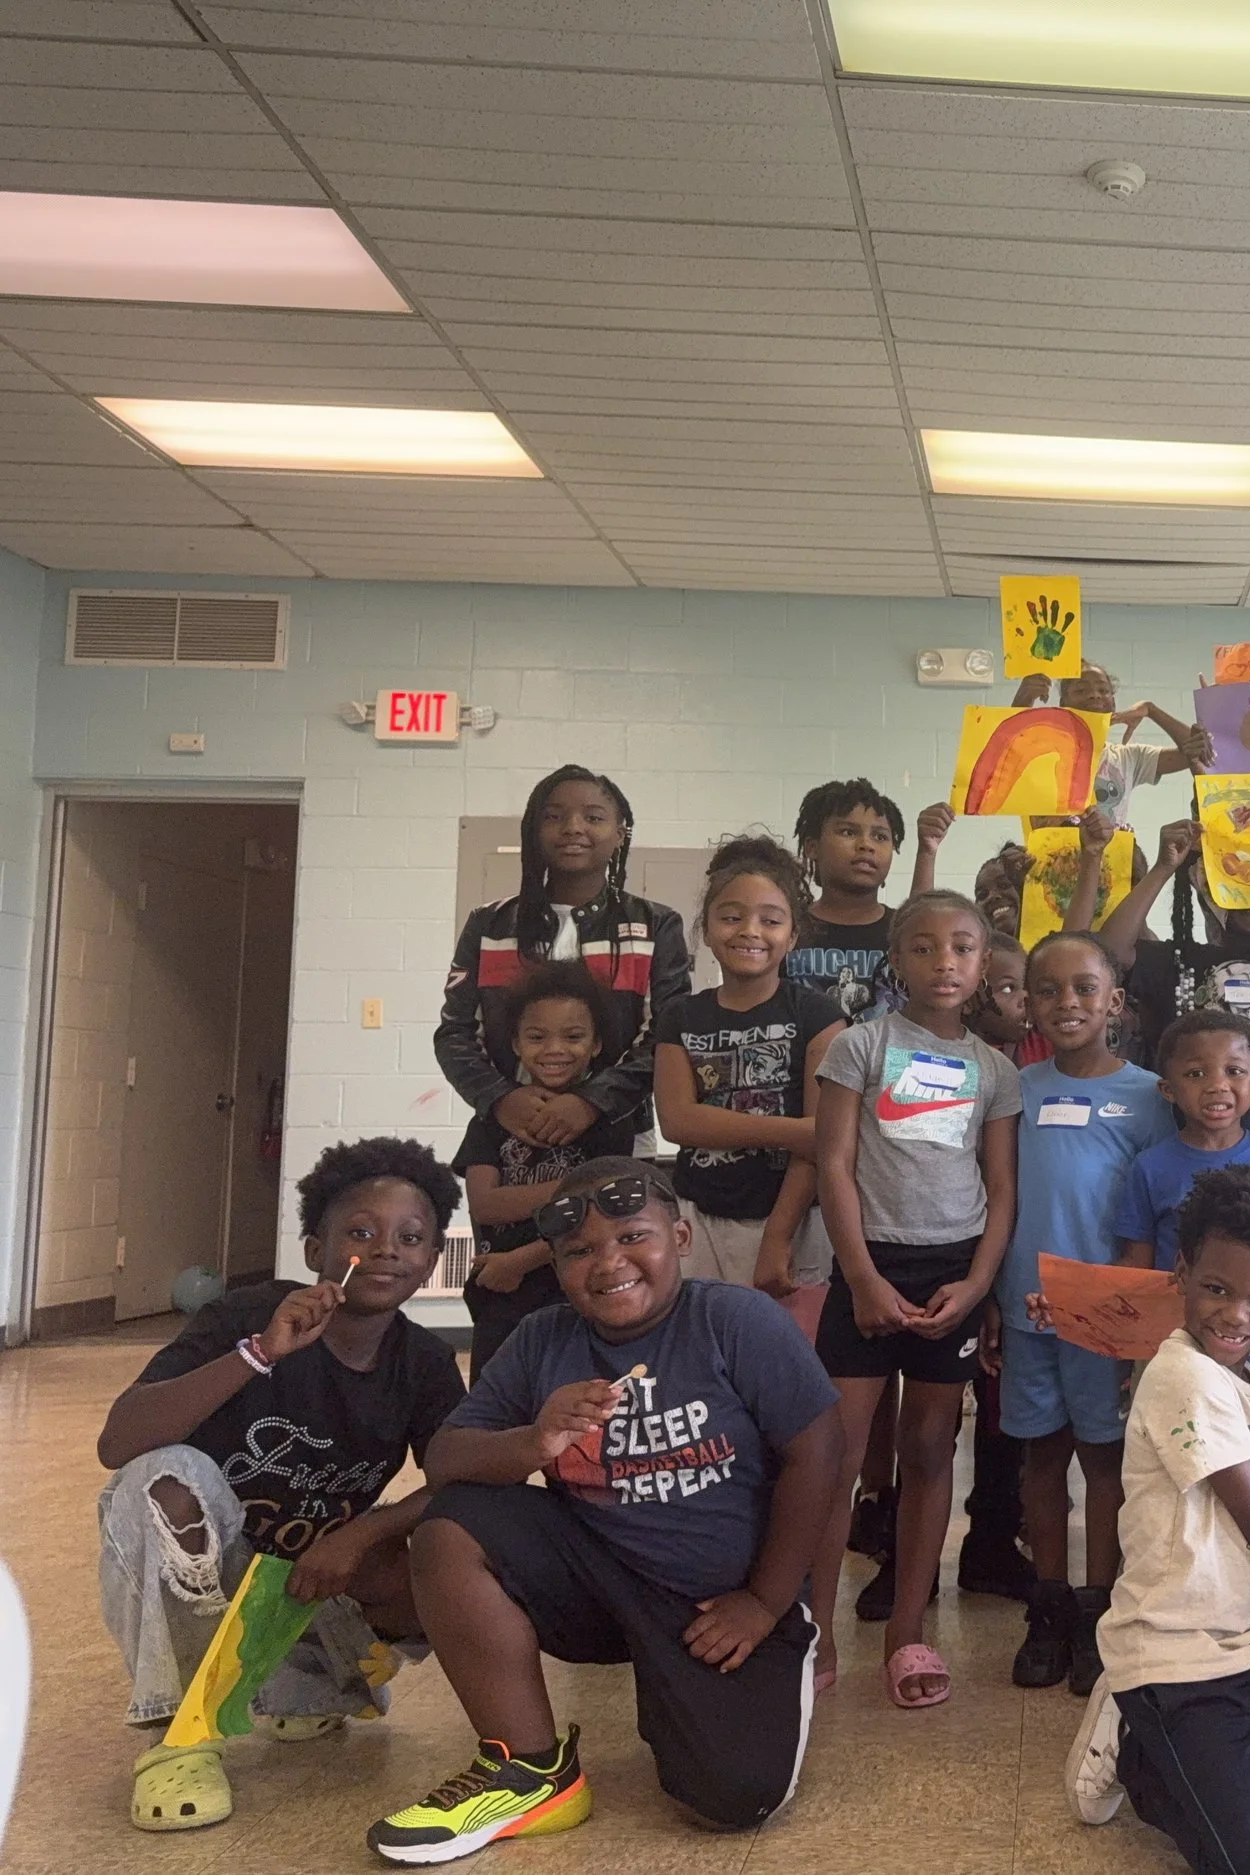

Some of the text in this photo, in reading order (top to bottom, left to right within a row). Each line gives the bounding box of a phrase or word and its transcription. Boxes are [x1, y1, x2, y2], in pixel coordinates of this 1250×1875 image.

[390, 693, 448, 732] EXIT
[786, 948, 890, 979] MICHA
[719, 1022, 797, 1048] FRIENDS
[1104, 1101, 1128, 1114] NIKE
[606, 1400, 709, 1457] SLEEP
[610, 1433, 735, 1480] BASKETBALL
[611, 1454, 737, 1504] REPEAT
